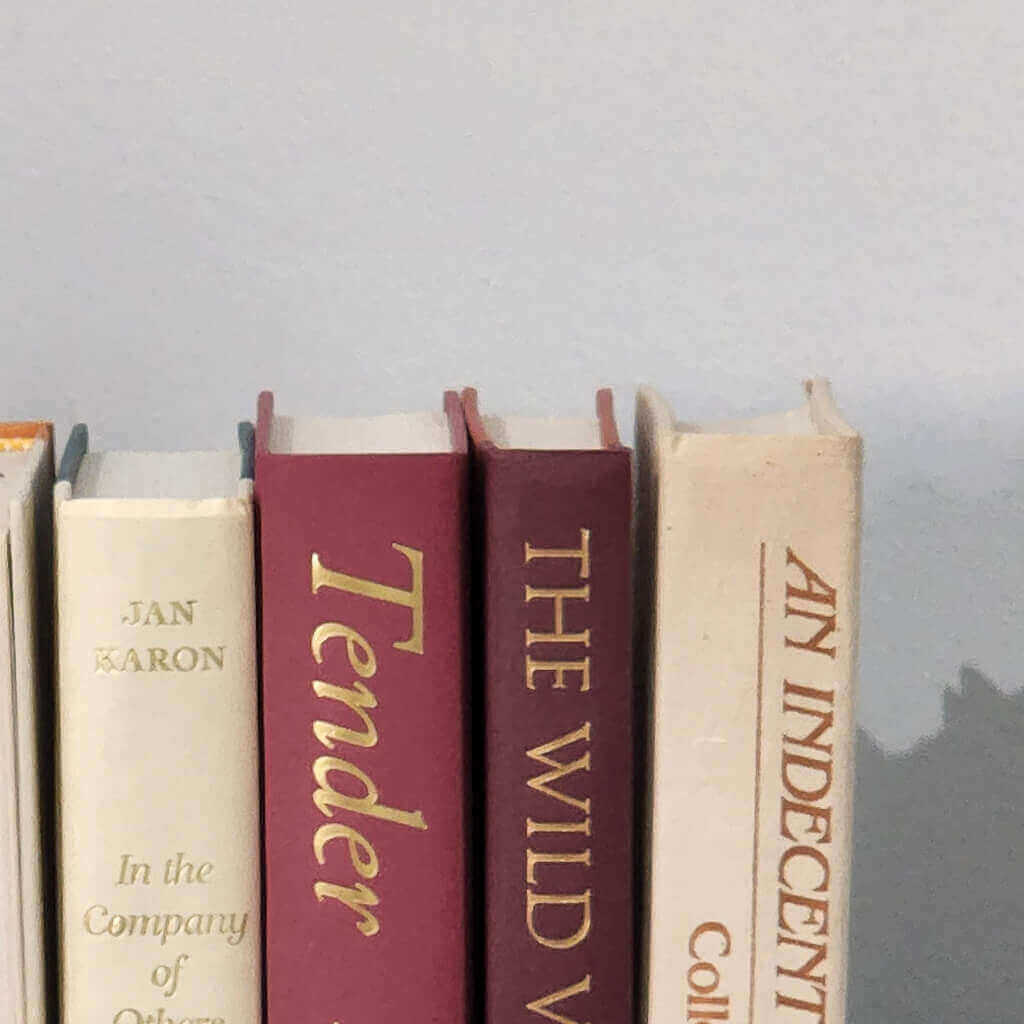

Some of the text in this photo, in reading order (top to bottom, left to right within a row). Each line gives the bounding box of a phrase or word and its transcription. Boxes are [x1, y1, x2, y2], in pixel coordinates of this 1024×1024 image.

[121, 600, 198, 625] JAN
[525, 528, 591, 692] THE
[785, 546, 838, 659] AN
[94, 646, 227, 673] KARON
[311, 542, 428, 937] Tender
[525, 722, 591, 949] WILD
[116, 852, 214, 886] In the
[83, 904, 248, 946] Company
[150, 954, 189, 998] of
